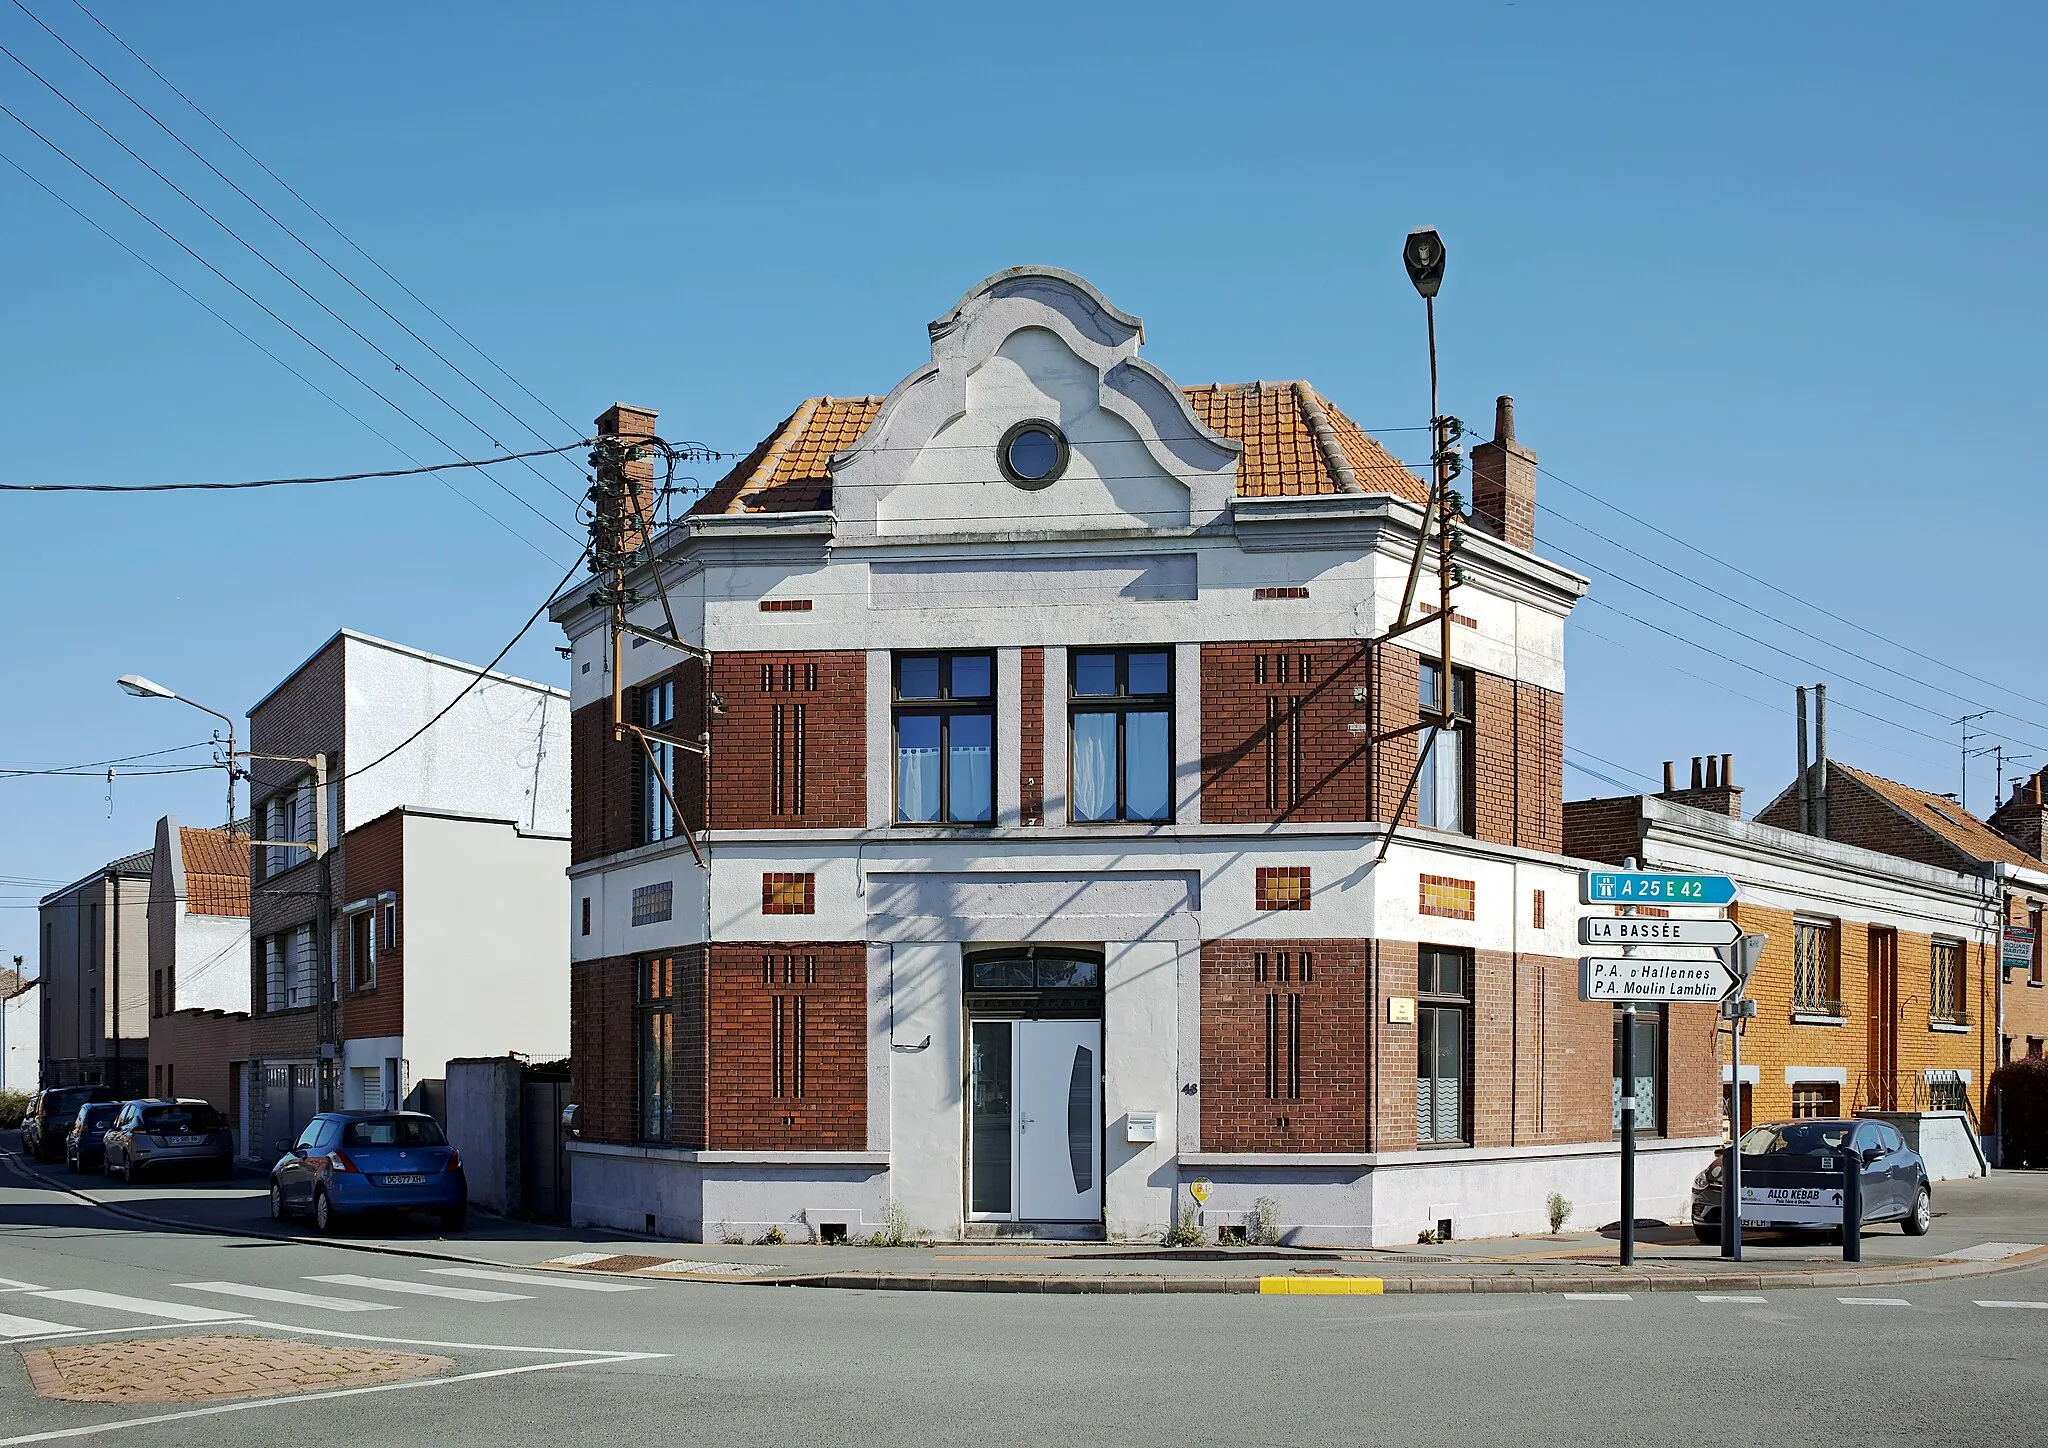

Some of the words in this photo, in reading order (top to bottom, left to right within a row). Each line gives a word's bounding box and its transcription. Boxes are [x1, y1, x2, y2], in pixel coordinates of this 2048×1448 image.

[1621, 880, 1632, 896] A
[1638, 881, 1661, 896] 25
[1666, 881, 1675, 897] E
[1680, 882, 1702, 897] 42
[1594, 924, 1611, 937] LA
[1620, 923, 1681, 938] BASSÉE
[1594, 965, 1622, 977] P.A.
[1594, 981, 1619, 993] P.A.
[1624, 982, 1665, 995] Moulin
[1670, 983, 1717, 996] Lamblin
[1768, 1190, 1788, 1199] ALLO
[1791, 1190, 1820, 1200] KEBAB
